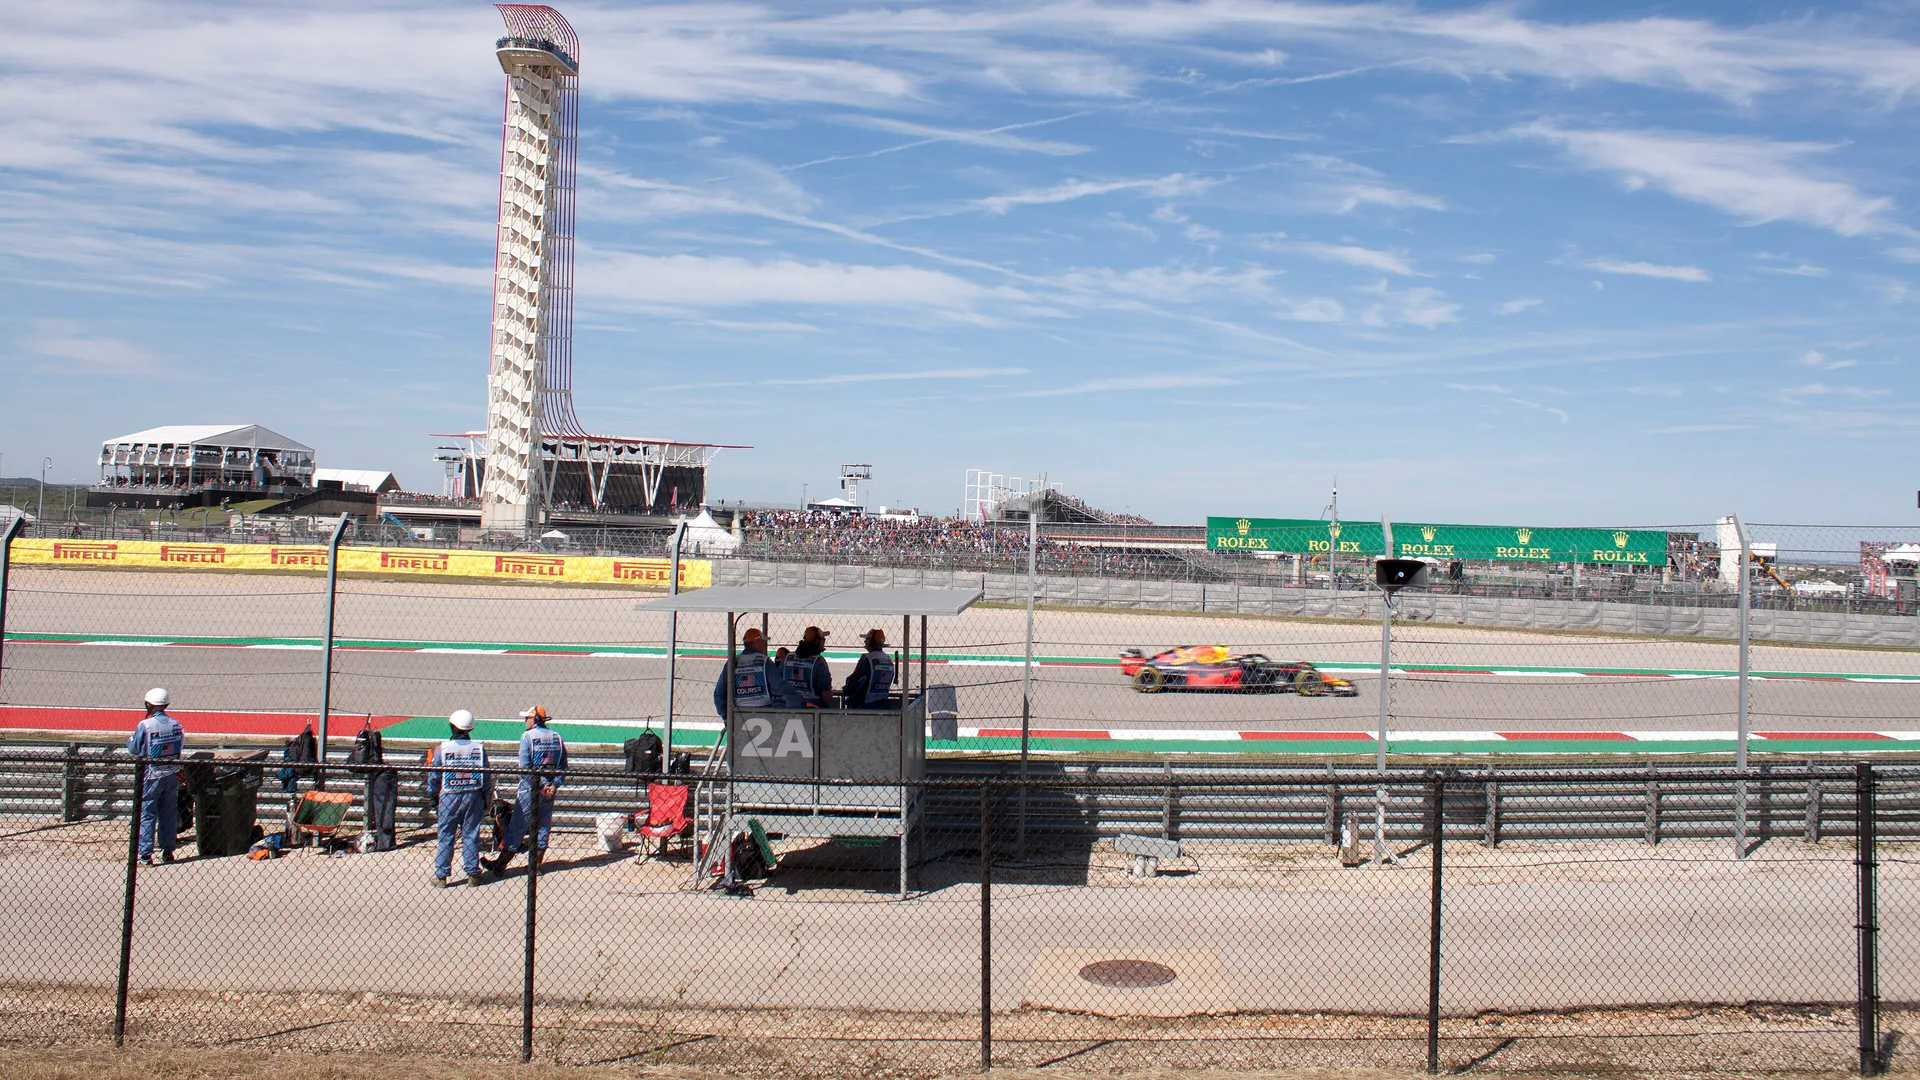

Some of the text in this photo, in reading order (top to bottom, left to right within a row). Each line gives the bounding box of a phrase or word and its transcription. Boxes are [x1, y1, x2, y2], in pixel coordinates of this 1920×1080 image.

[53, 542, 118, 561] PIRELLI
[1217, 537, 1269, 549] ROLEX
[1308, 540, 1360, 552] ROLEX
[1401, 543, 1455, 556] ROLEX
[161, 545, 226, 563] PIRELLI
[271, 548, 329, 566] PIRELL
[381, 551, 449, 570] PIRELLI
[1496, 546, 1551, 559] ROLEX
[1592, 549, 1649, 563] ROLEX
[495, 555, 565, 577] PIRELLI
[613, 561, 686, 582] PIRELI
[736, 686, 762, 695] COURSE
[740, 718, 814, 758] 2A
